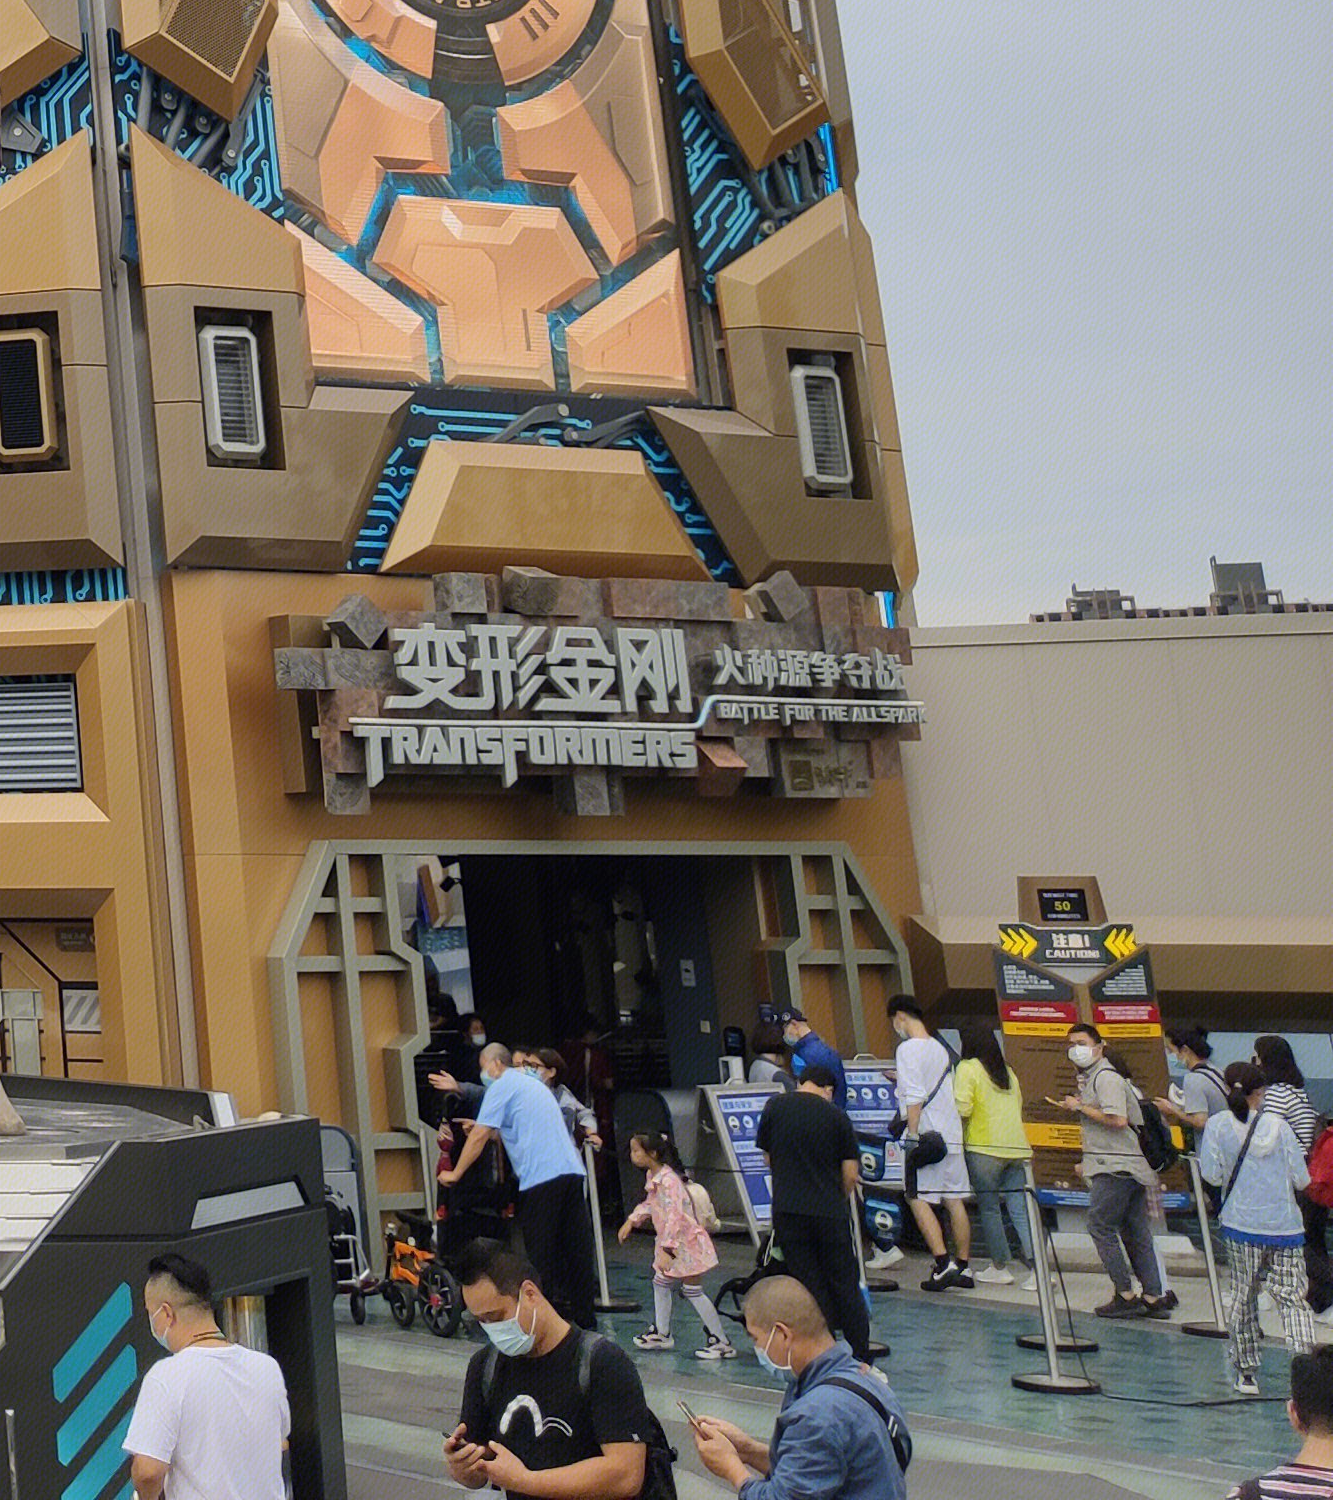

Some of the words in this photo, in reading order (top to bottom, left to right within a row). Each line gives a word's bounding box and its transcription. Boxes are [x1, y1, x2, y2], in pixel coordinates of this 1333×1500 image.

[383, 622, 694, 714] 变形金刚
[712, 642, 906, 692] 火种源争夺战
[717, 702, 781, 725] BATTLE
[784, 704, 816, 726] FOR
[819, 705, 848, 722] THE
[851, 706, 928, 724] ALLSPARK
[352, 725, 698, 789] TRANSFORMERS
[1054, 900, 1071, 911] 50
